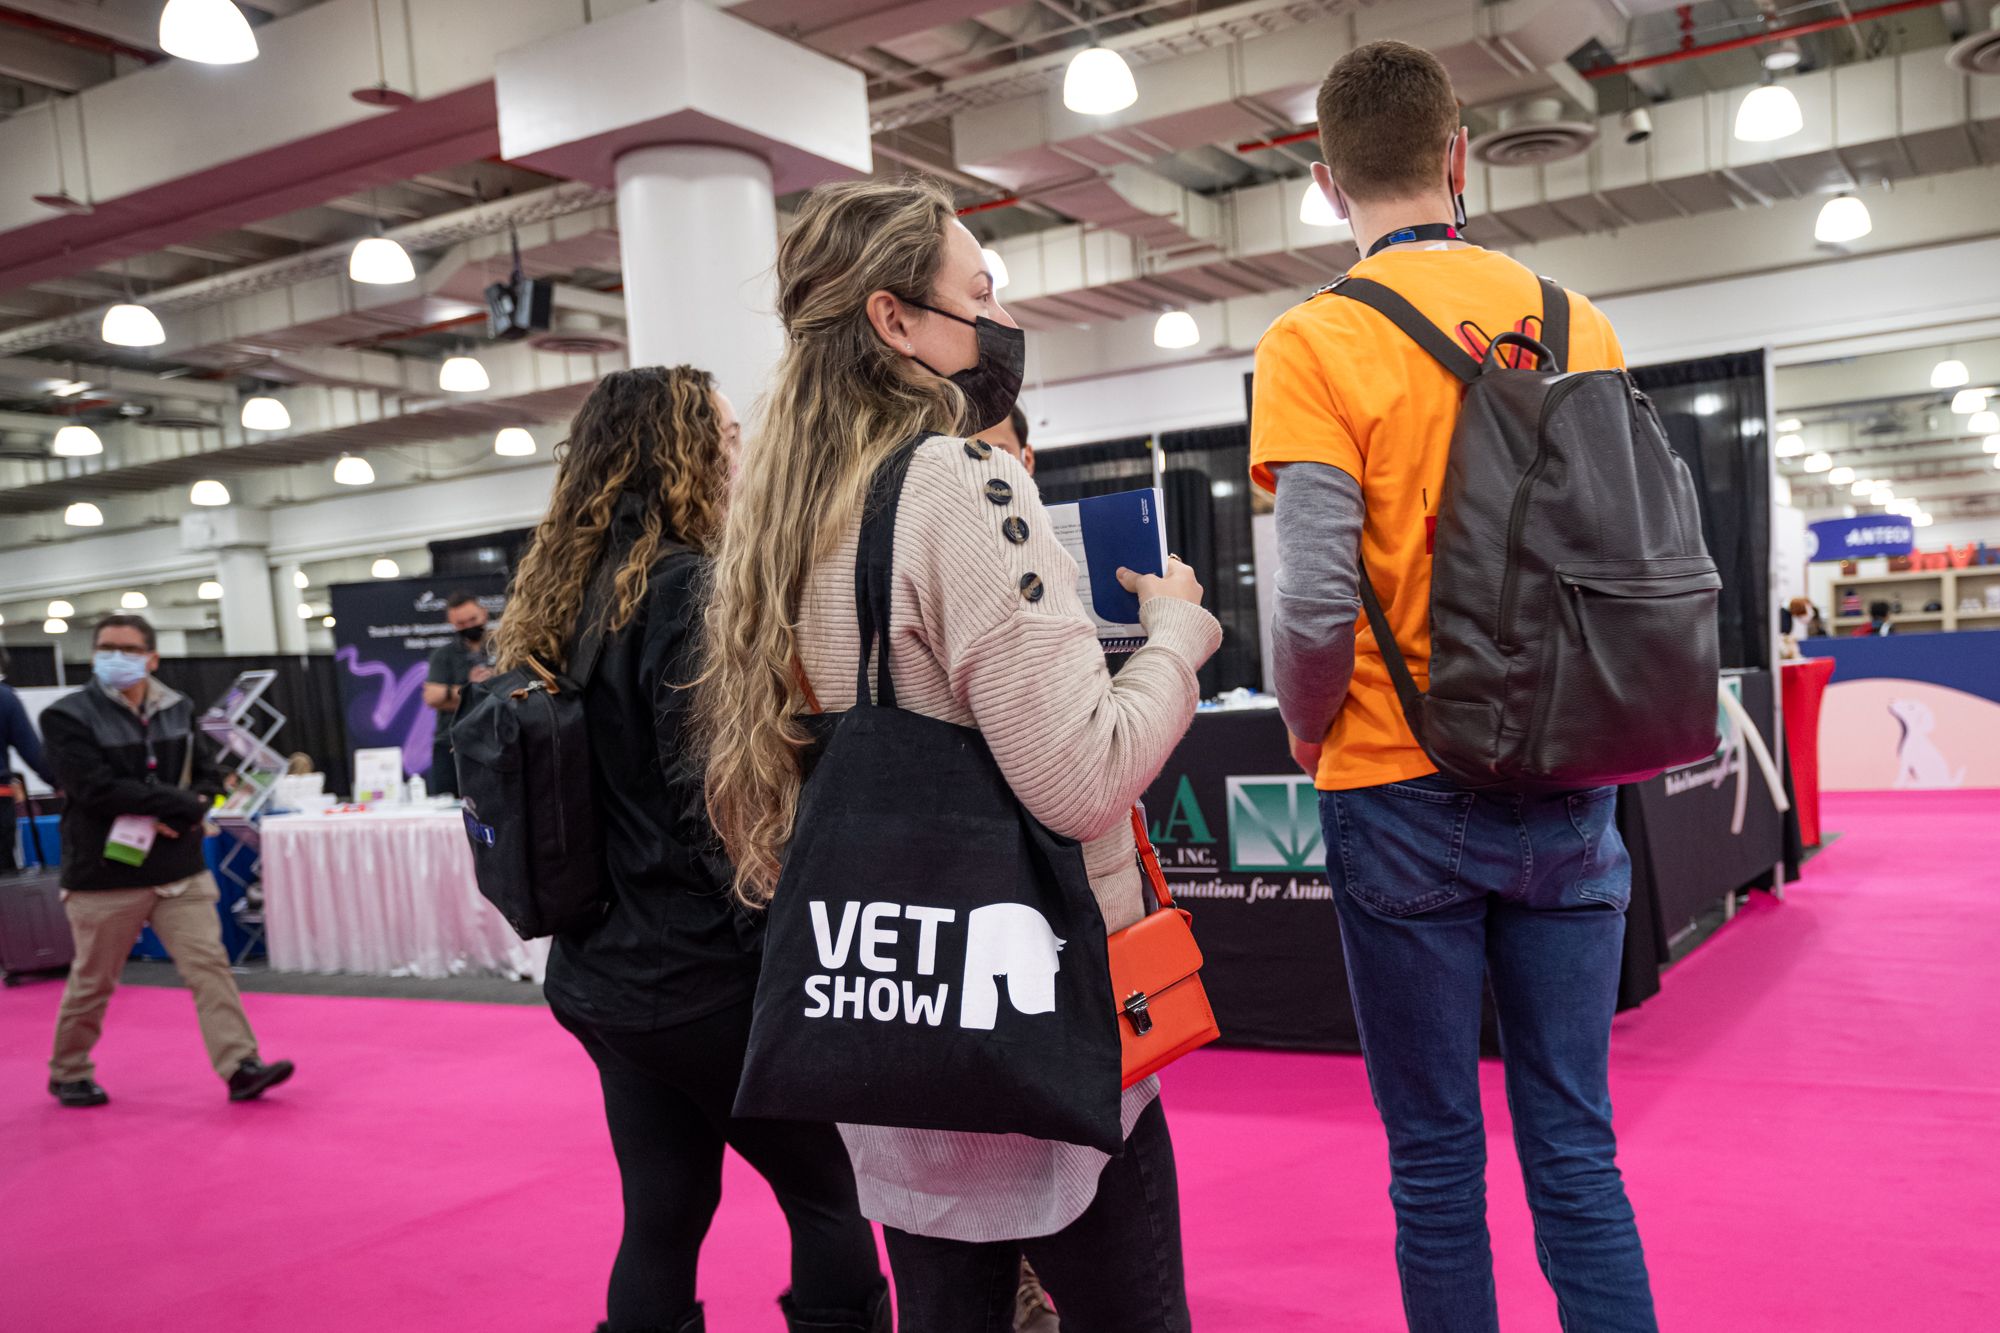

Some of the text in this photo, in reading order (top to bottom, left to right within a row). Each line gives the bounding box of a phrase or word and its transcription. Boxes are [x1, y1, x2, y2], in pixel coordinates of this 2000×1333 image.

[1246, 876, 1282, 904] for
[809, 901, 956, 975] VET
[803, 974, 949, 1027] SHOW
